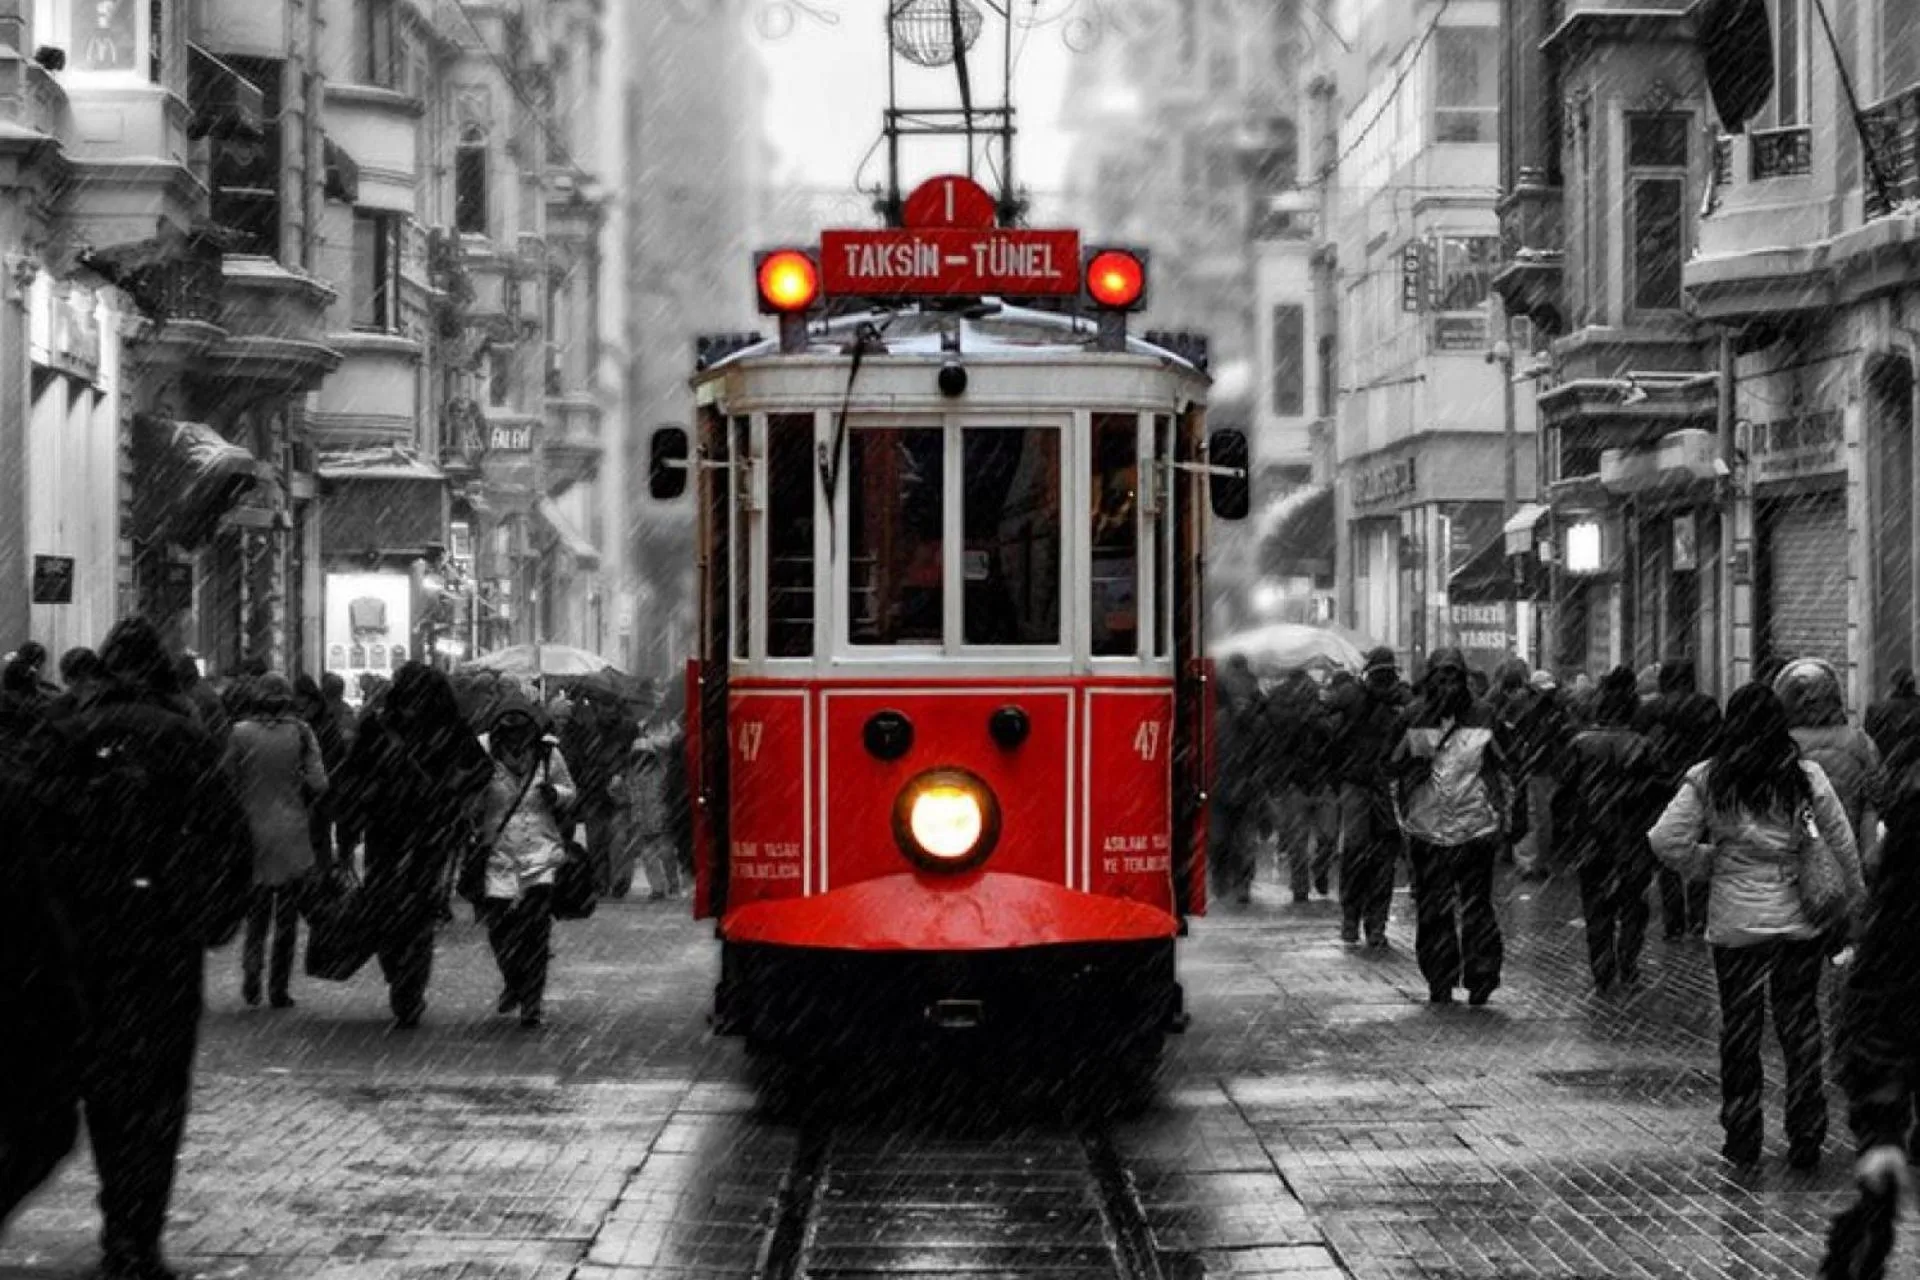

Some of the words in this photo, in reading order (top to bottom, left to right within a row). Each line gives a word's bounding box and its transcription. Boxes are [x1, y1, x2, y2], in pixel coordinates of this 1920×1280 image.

[971, 237, 1062, 277] TÜNEL
[738, 721, 764, 761] 47
[1133, 720, 1161, 761] 47
